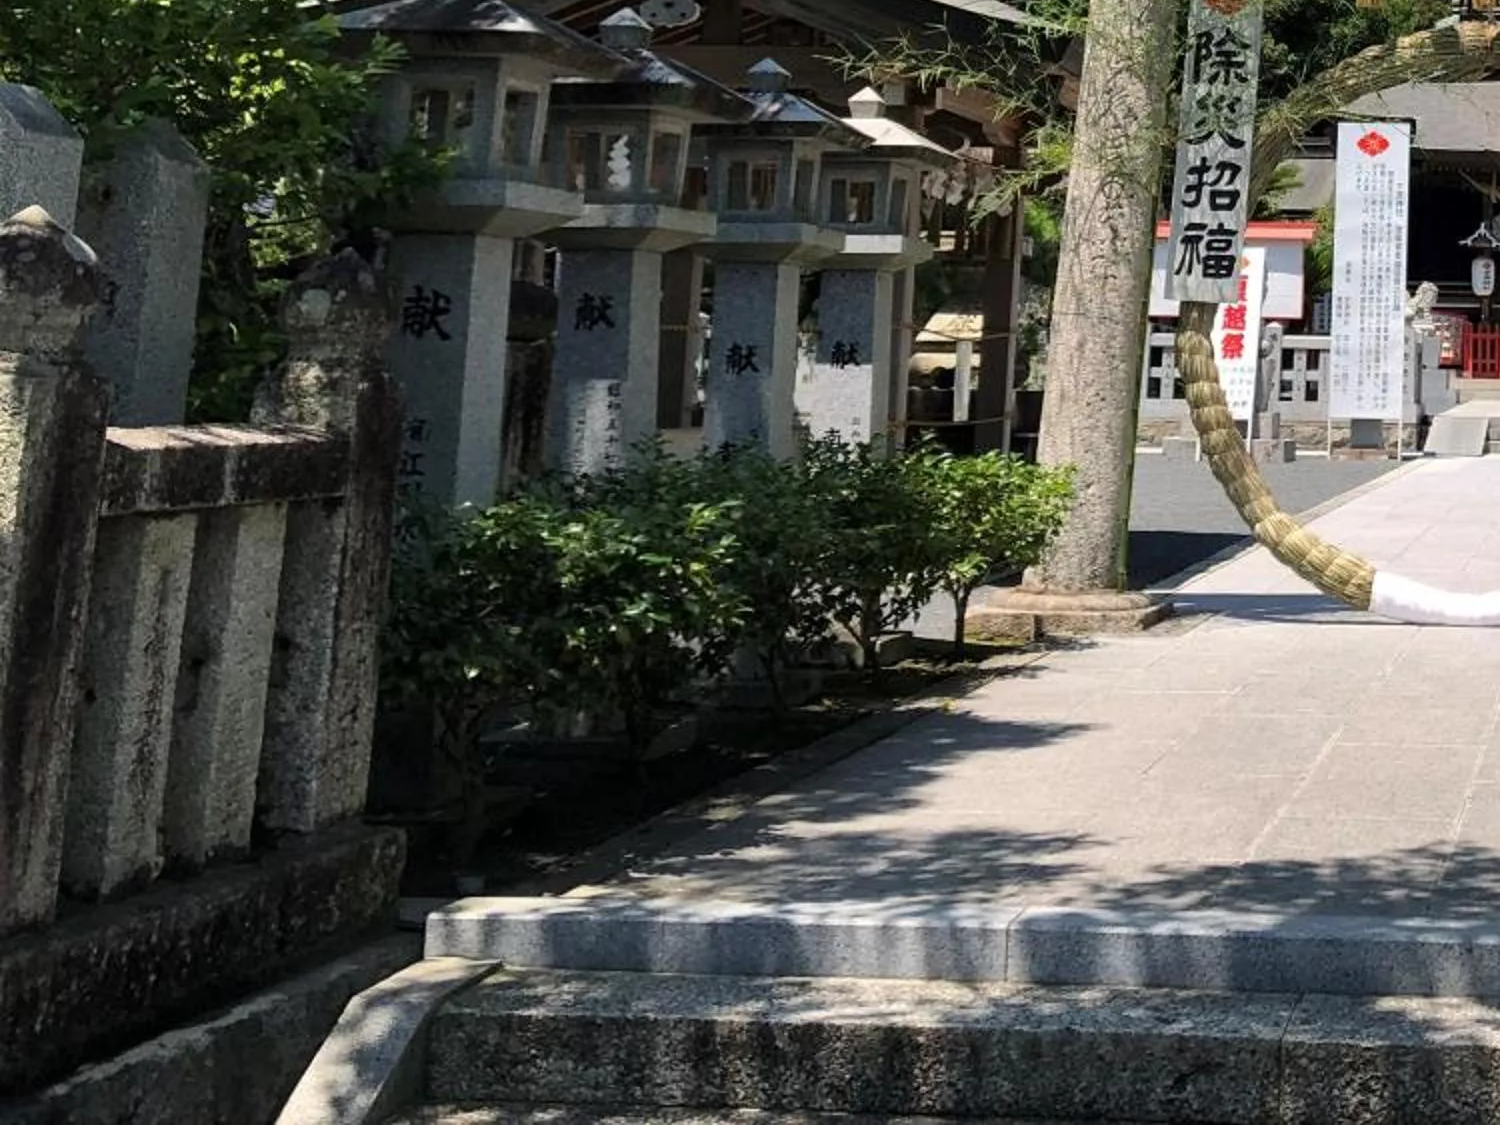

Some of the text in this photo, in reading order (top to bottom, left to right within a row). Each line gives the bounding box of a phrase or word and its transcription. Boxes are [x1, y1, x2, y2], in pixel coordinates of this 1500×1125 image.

[1174, 27, 1252, 280] 除災招福
[402, 284, 453, 342] 献
[574, 292, 617, 331] 献
[725, 340, 761, 375] 献
[830, 339, 862, 369] 献
